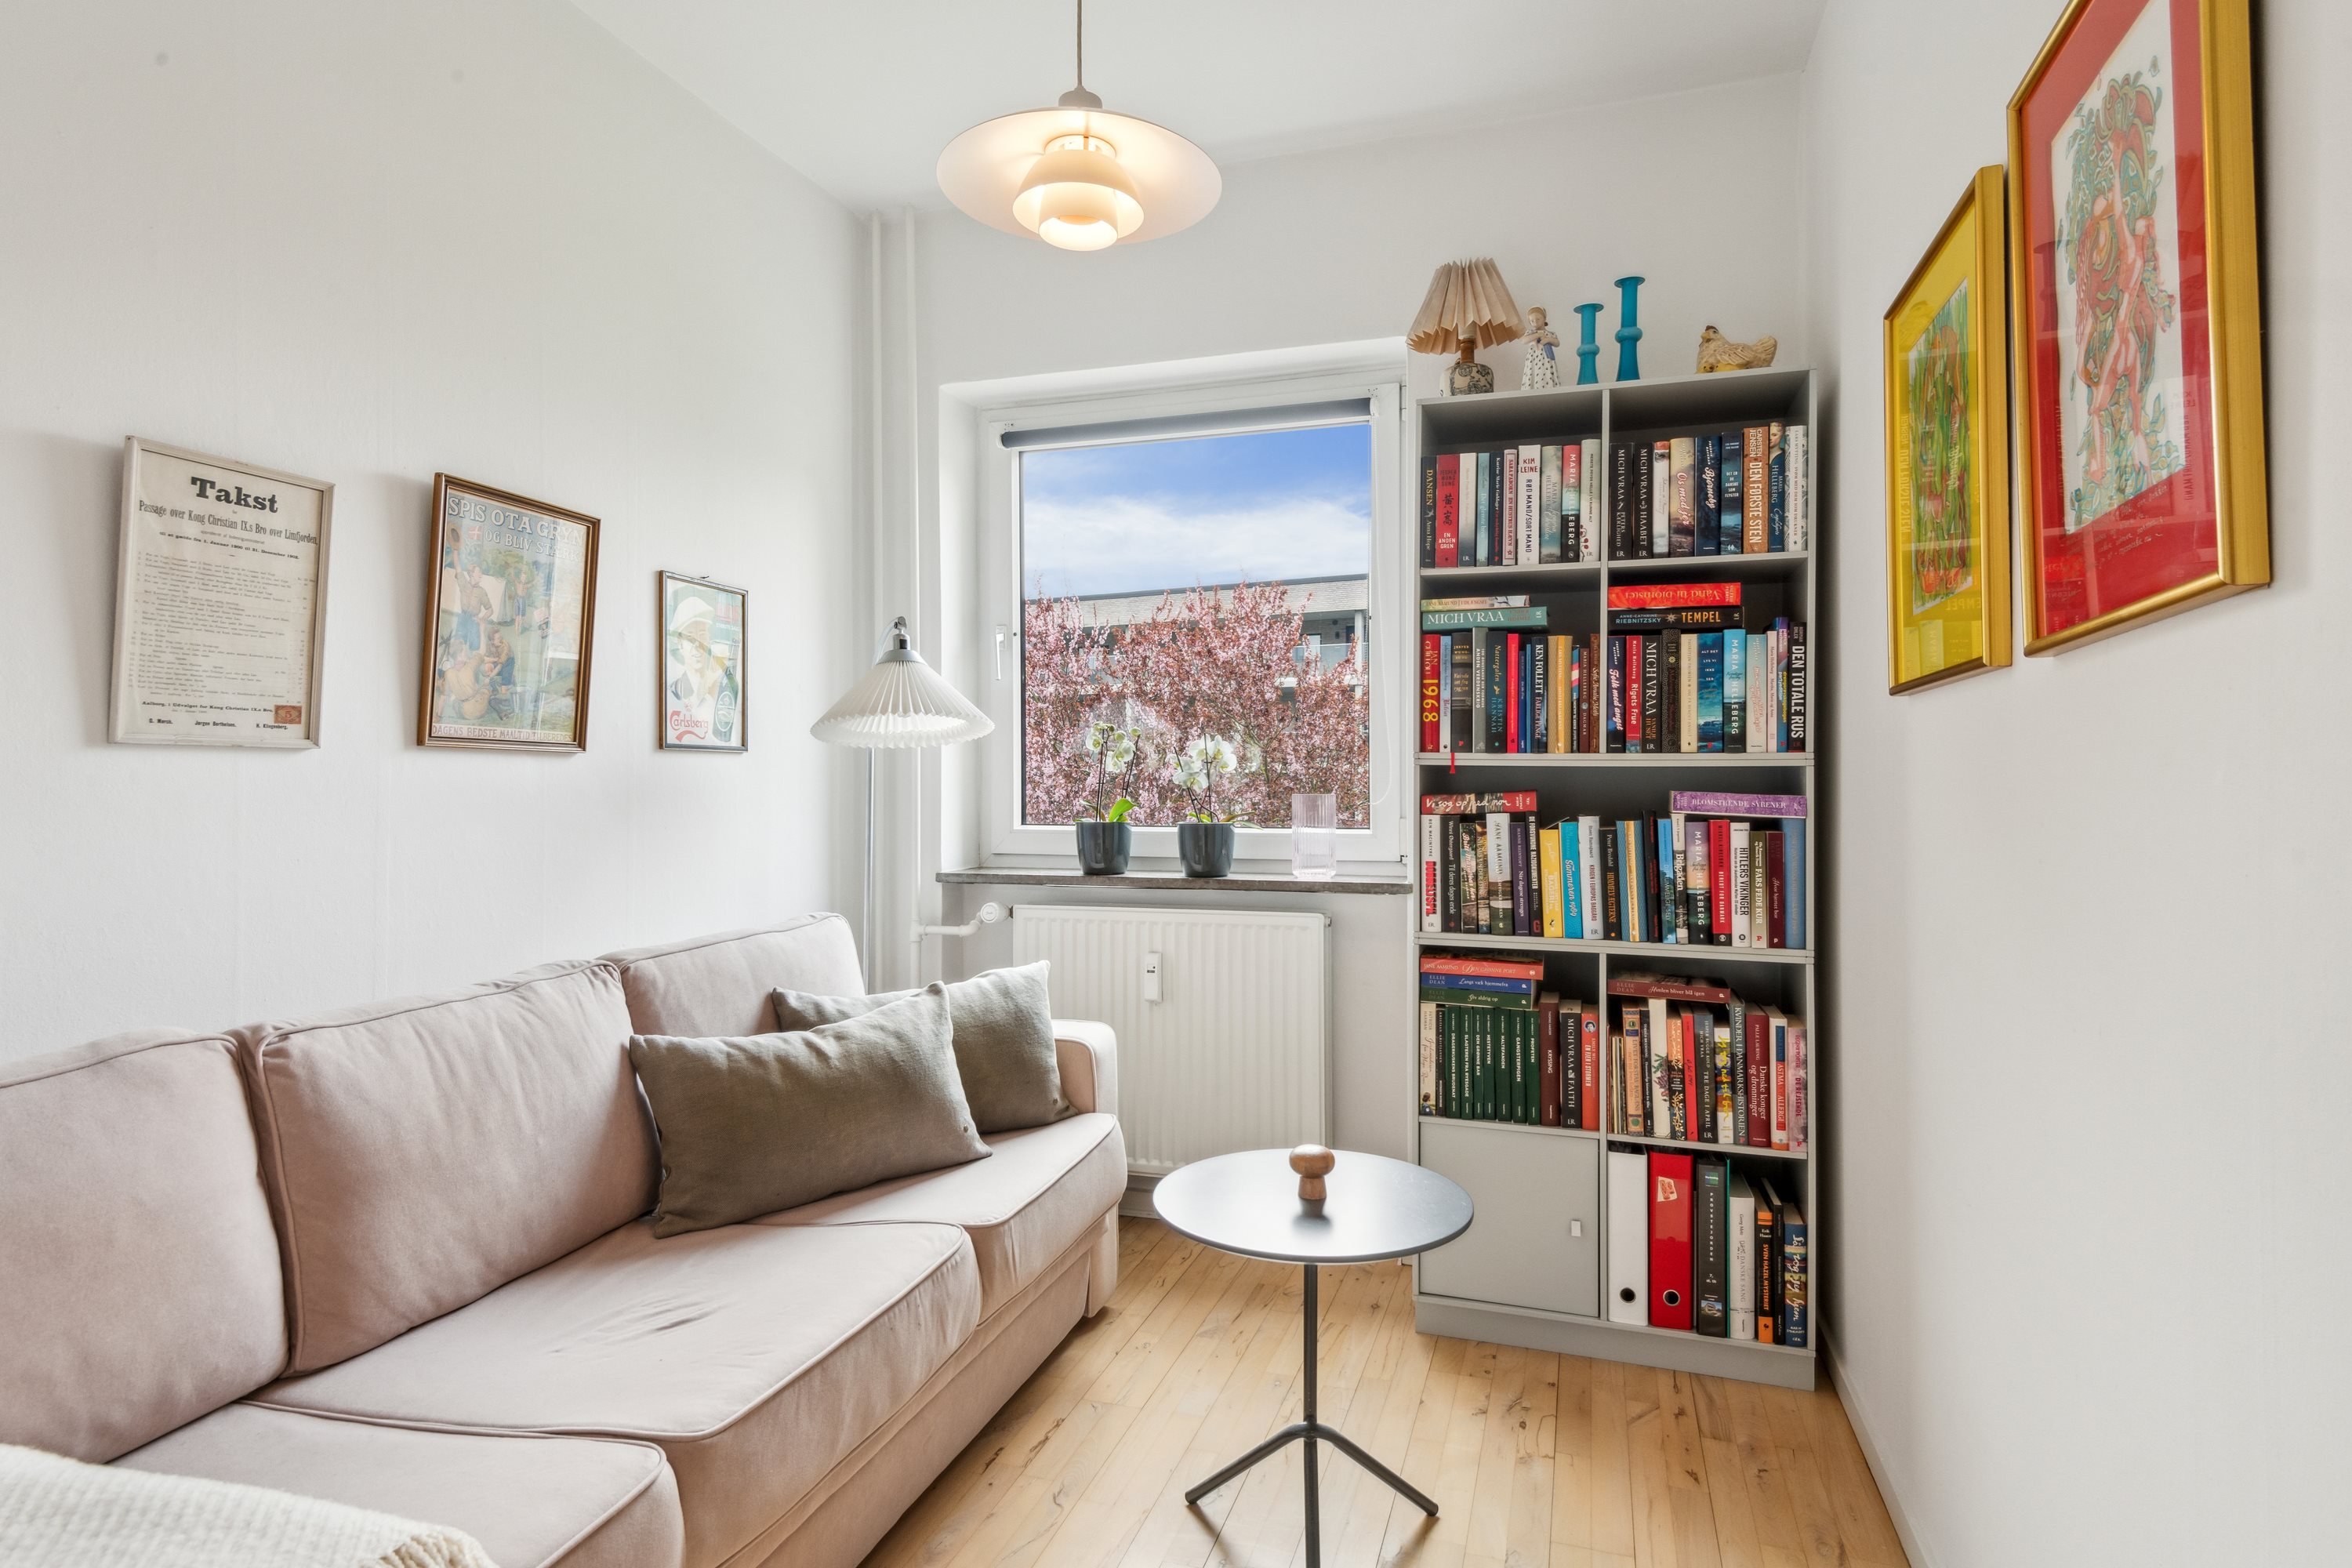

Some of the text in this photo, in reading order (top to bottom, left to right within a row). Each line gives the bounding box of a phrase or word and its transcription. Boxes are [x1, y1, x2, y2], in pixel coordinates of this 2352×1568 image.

[191, 475, 278, 514] Takst
[1677, 472, 1687, 485] Os
[1679, 488, 1690, 507] mod
[1703, 466, 1716, 508] Bjørneby
[139, 499, 167, 517] Passage
[169, 508, 186, 520] over
[187, 510, 205, 526] Kong
[208, 514, 238, 530] Christian
[241, 520, 253, 532] IX.s
[255, 523, 267, 535] Bro
[269, 528, 283, 538] over
[285, 528, 318, 546] Limfjorden,
[448, 496, 585, 546] SPIS OTA GRYN
[1678, 508, 1690, 525] jer
[1749, 463, 1762, 543] DEN FØRSTE STEN
[485, 529, 501, 544] OG
[505, 533, 533, 551] BLIV
[1428, 613, 1464, 624] MICH
[1467, 611, 1504, 622] VRAA
[1682, 612, 1721, 623] TEMPEL
[1493, 644, 1501, 682] Nattergalen
[1535, 644, 1544, 694] KEN FOLLETT
[1646, 642, 1657, 715] MICH VRAA
[1423, 679, 1439, 722] 1968
[1610, 669, 1624, 731] Folk med angst
[1629, 684, 1638, 706] Rigets
[1730, 681, 1739, 735] HELLEBERG
[1791, 645, 1805, 739] DEN TOTALE RUS
[432, 724, 463, 736] DAGENS
[466, 727, 498, 739] BEDSTE
[499, 729, 530, 739] MAALTID
[670, 710, 709, 735] Carlsberg
[1692, 798, 1787, 809] BLOMSTRENDE SYRENER
[1675, 854, 1685, 891] Brigaden
[1740, 848, 1749, 916] HITLERS VIKINGER
[1697, 873, 1705, 925] HELLEBERG
[1468, 993, 1477, 1002] Giv
[1736, 1048, 1745, 1136] DANMARKSHISTORIEN
[1748, 1065, 1759, 1116] og dronninger
[1757, 1094, 1768, 1120] konger
